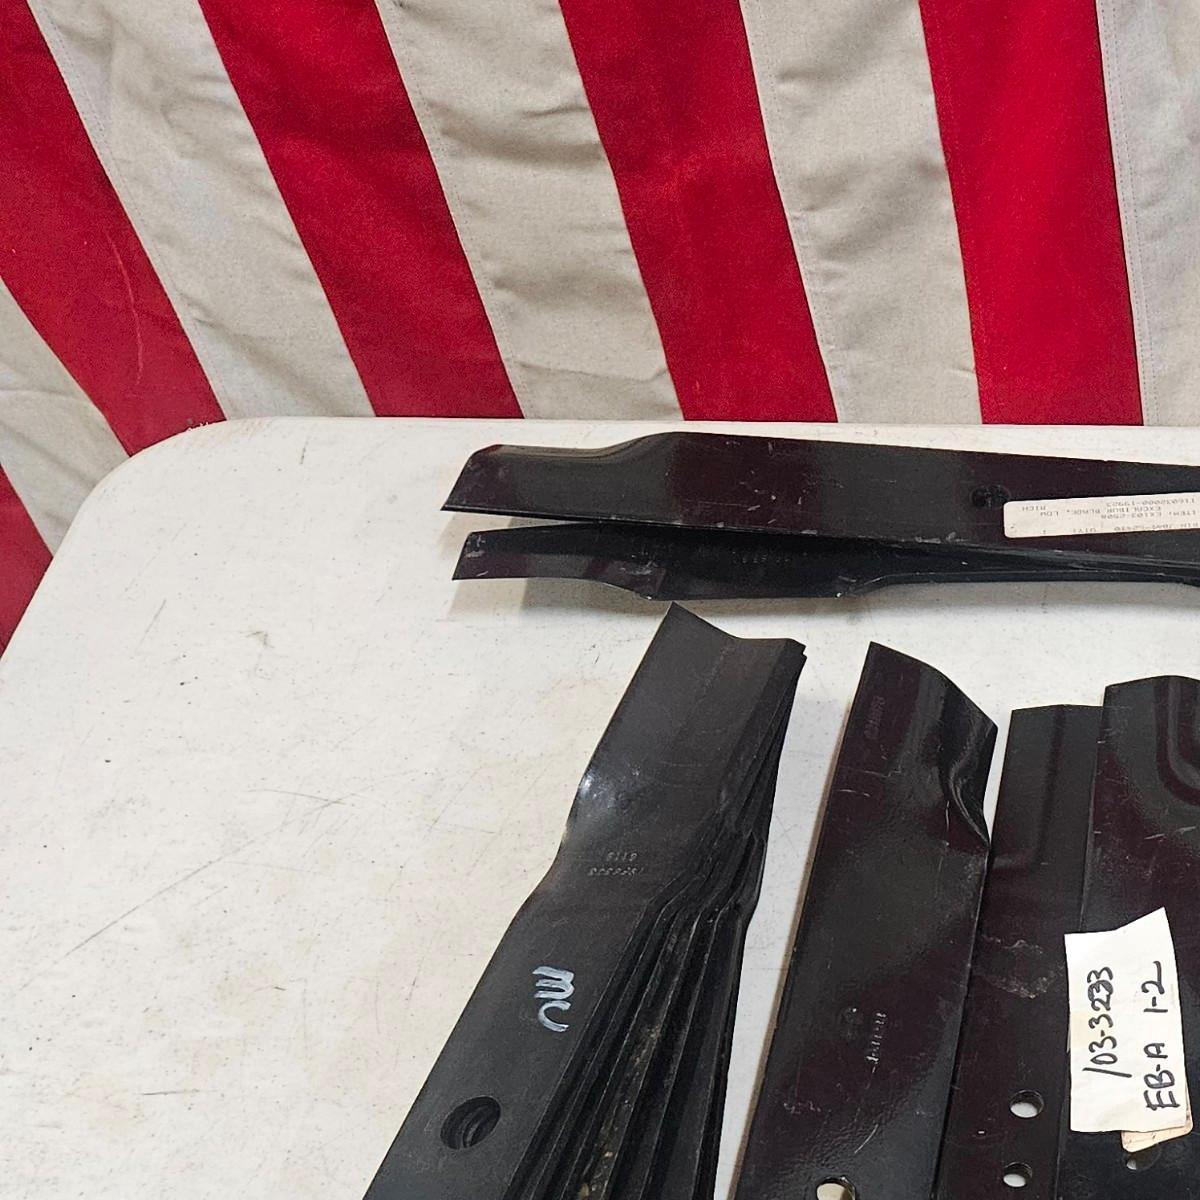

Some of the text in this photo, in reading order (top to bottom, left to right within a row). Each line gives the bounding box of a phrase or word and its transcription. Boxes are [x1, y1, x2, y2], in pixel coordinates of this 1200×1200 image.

[1082, 966, 1133, 1078] 103-3233
[1141, 960, 1180, 1111] EB-A 1-2
